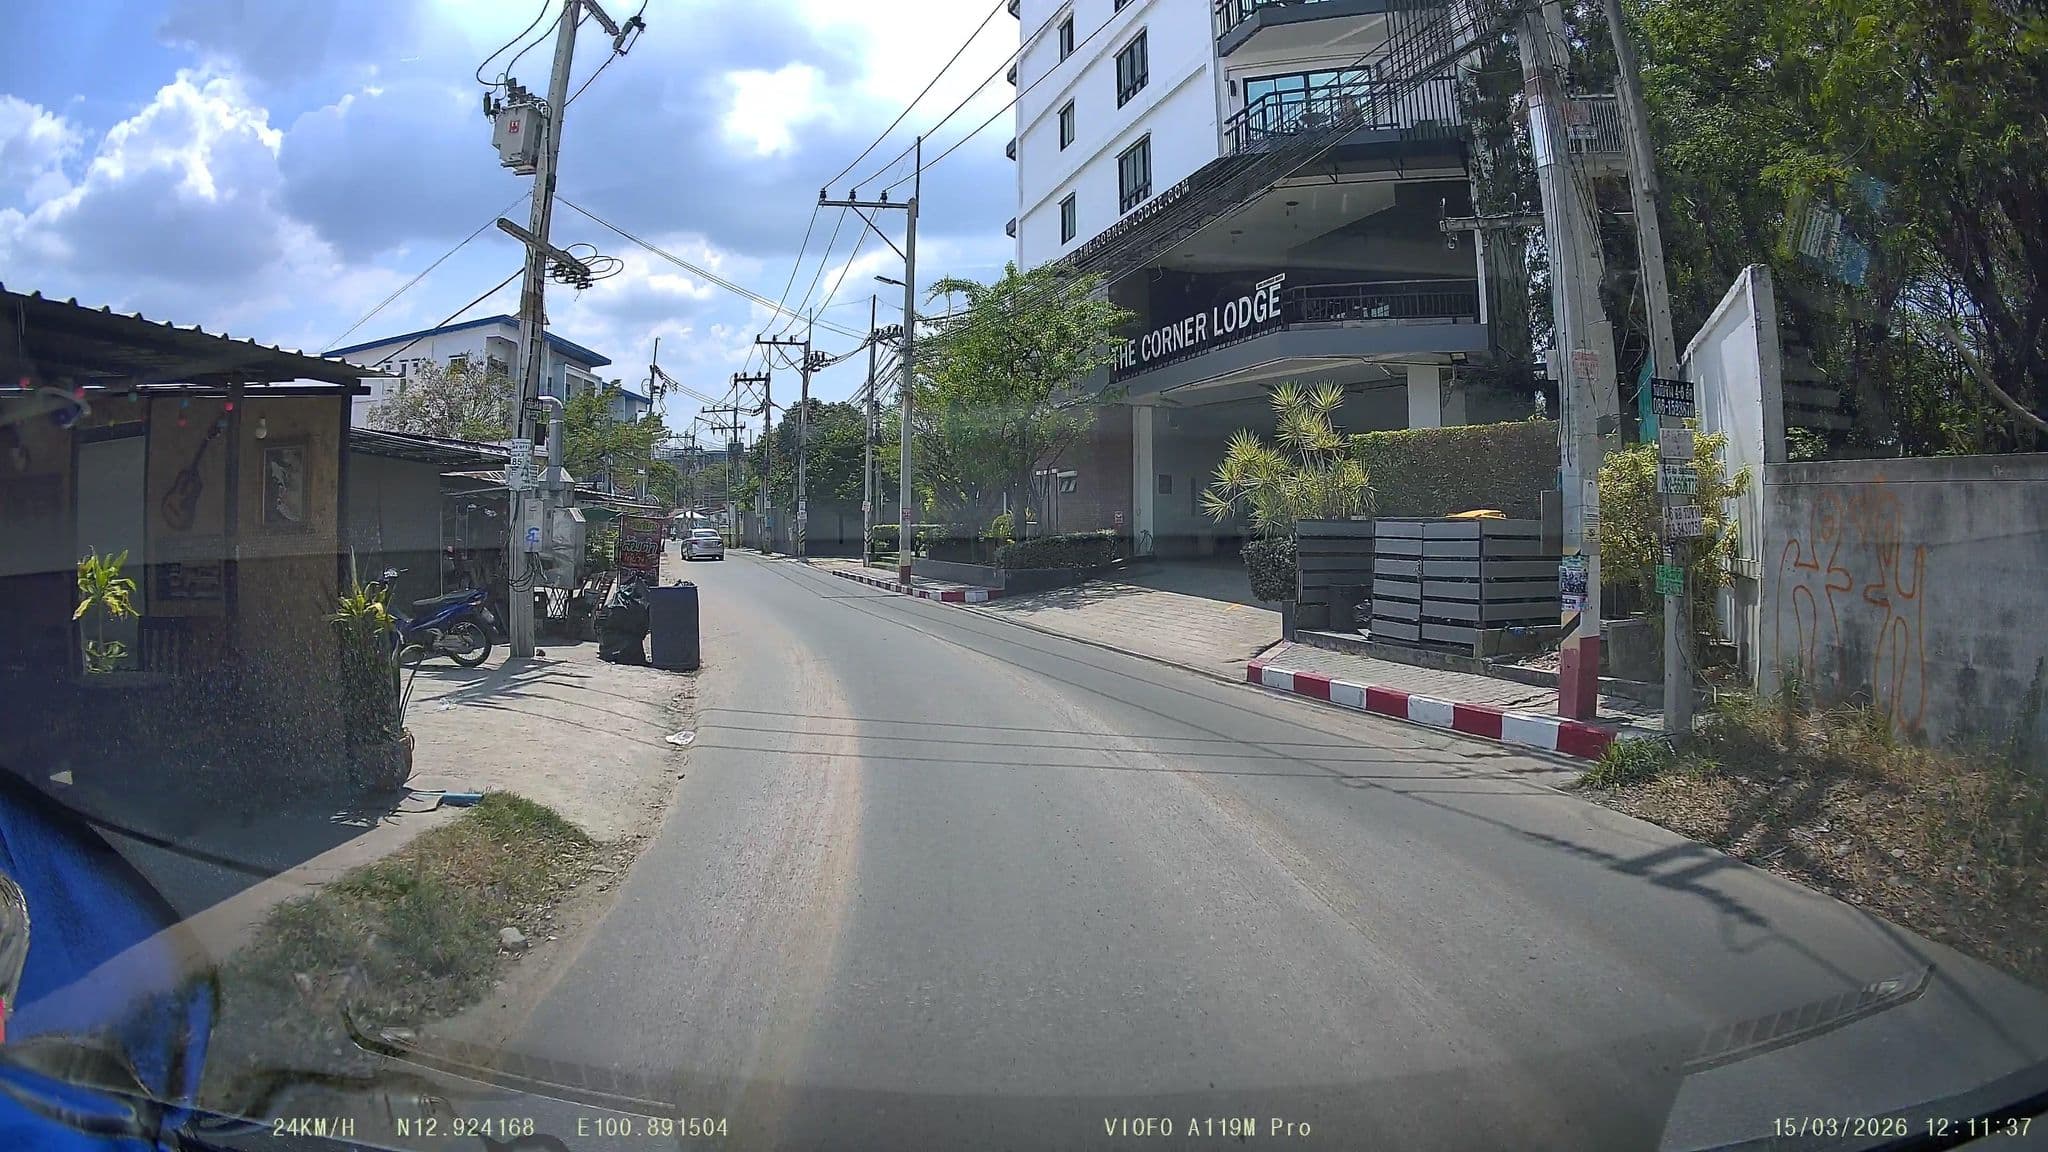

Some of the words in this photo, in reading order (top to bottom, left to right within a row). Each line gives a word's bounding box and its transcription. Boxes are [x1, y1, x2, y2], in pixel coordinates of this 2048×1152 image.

[1111, 338, 1137, 372] THE
[1141, 312, 1208, 363] CORNER
[1213, 283, 1282, 338] LODGE
